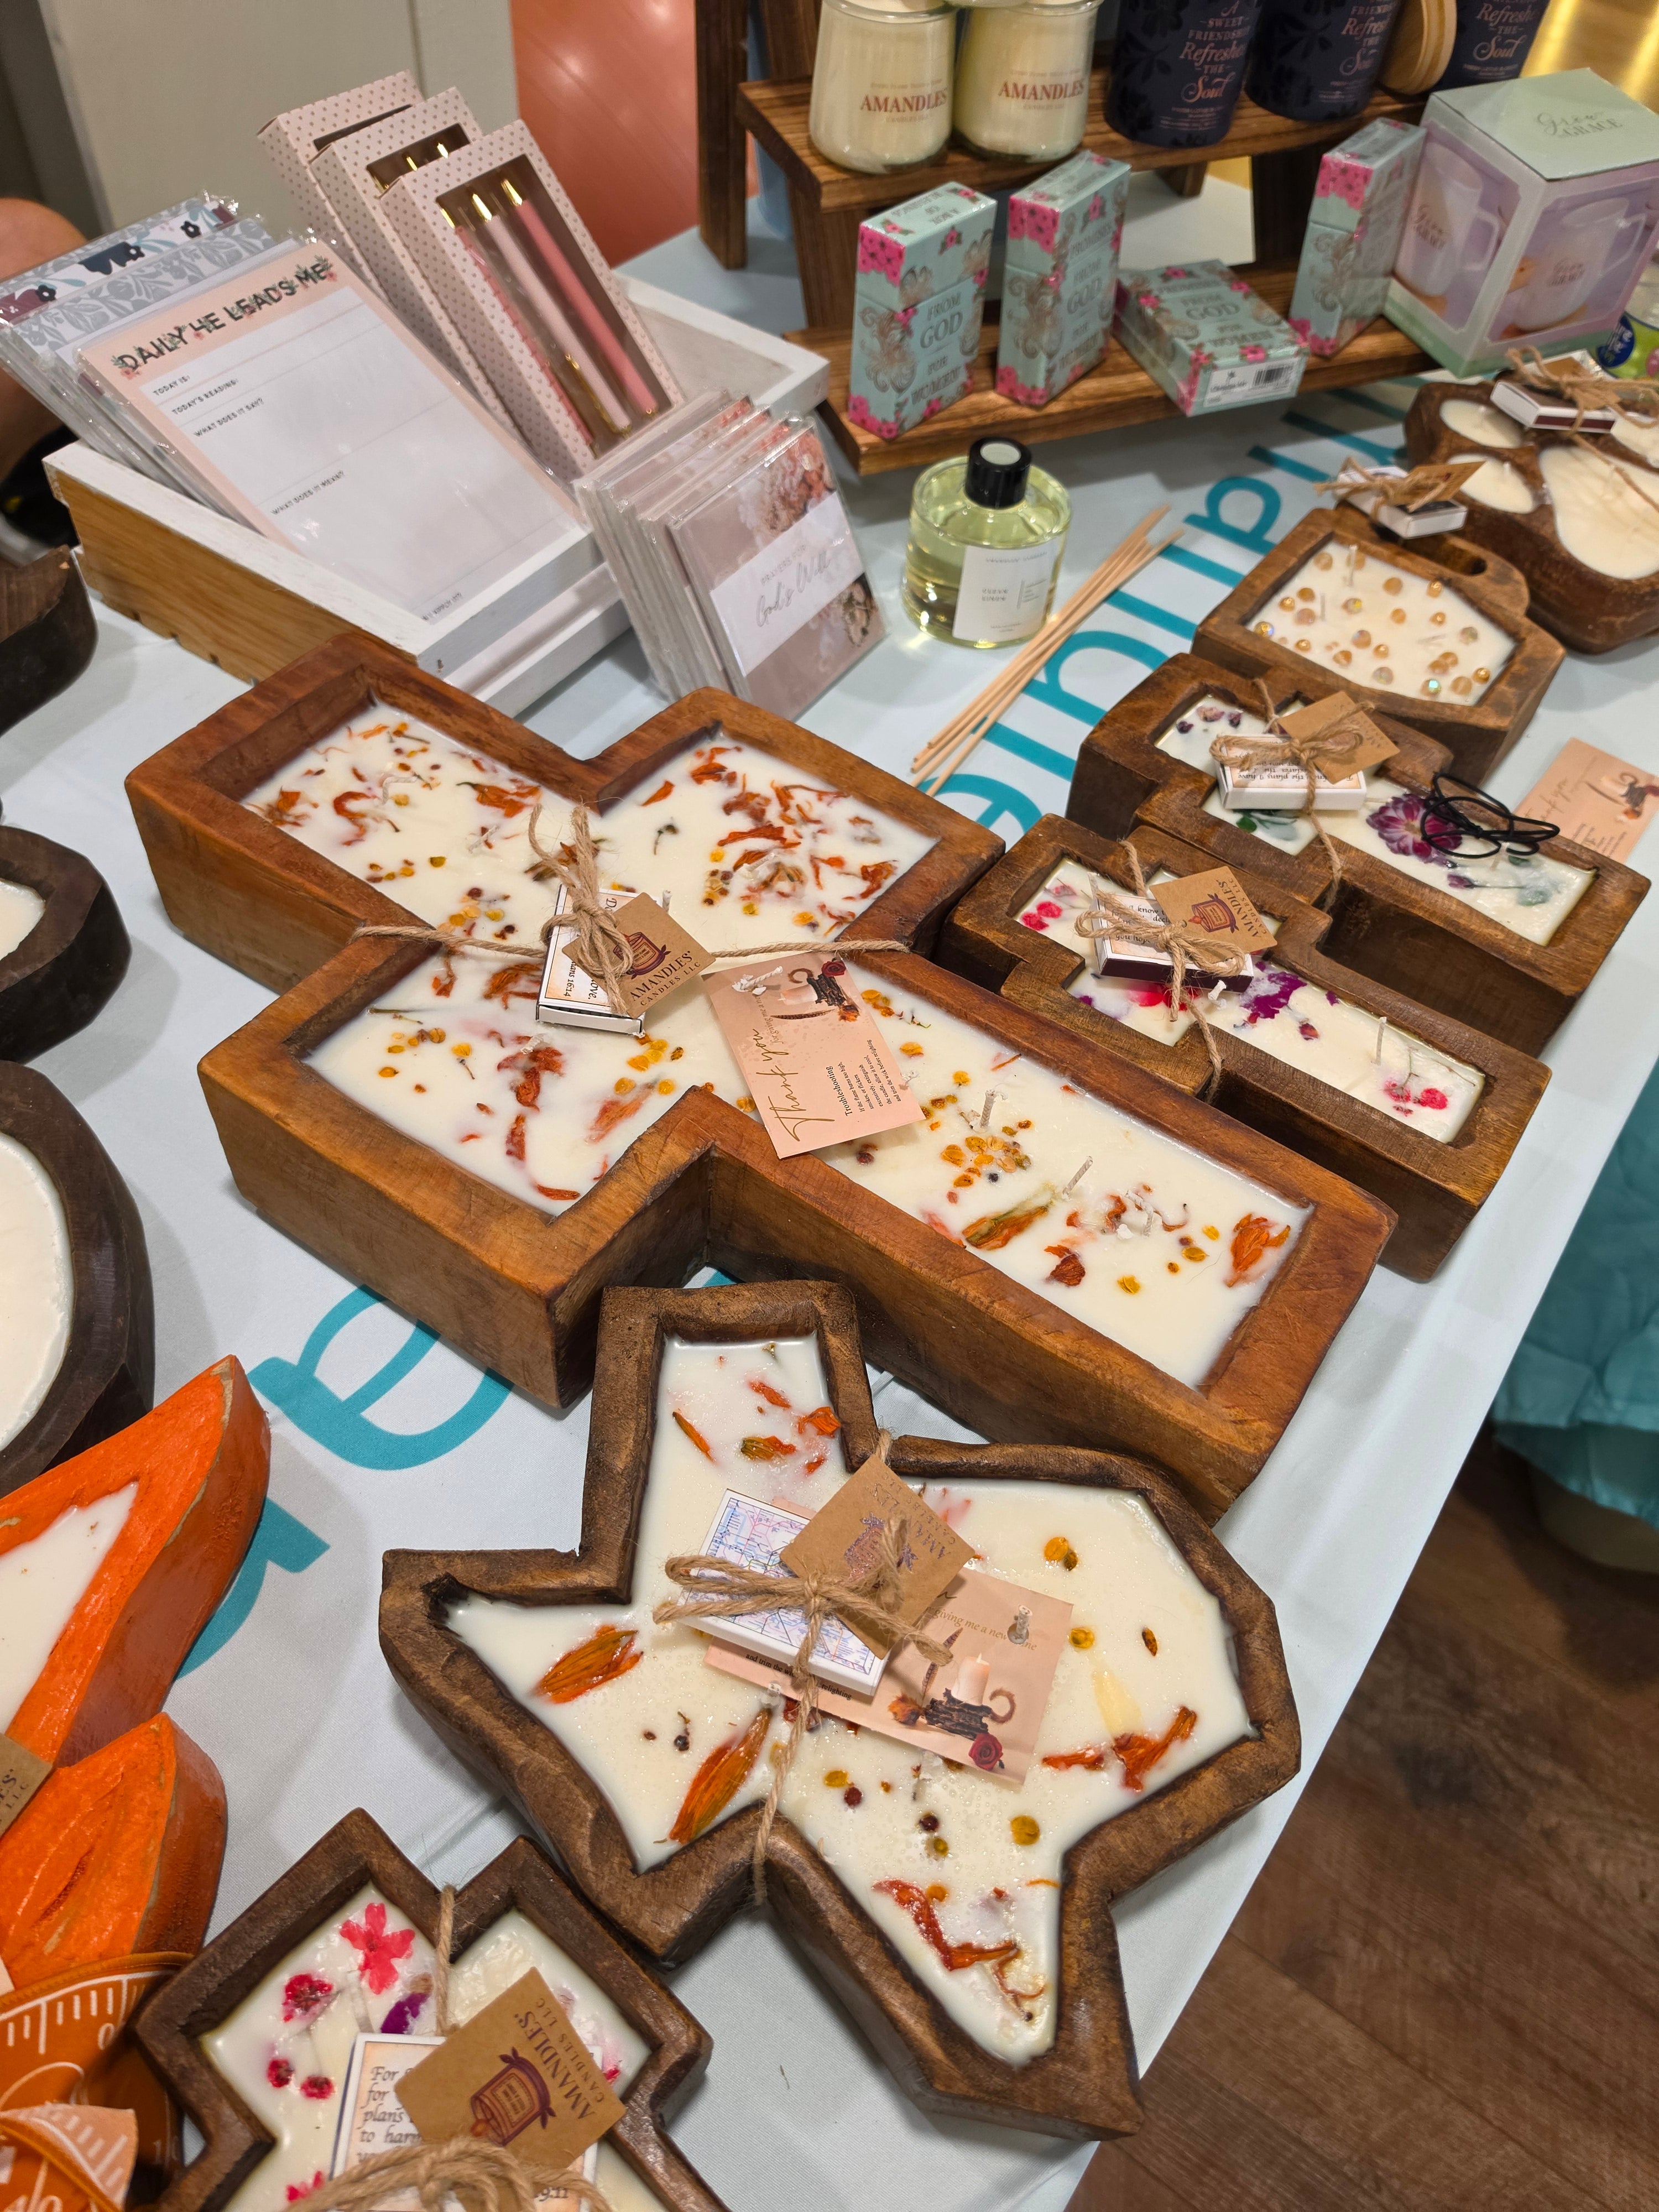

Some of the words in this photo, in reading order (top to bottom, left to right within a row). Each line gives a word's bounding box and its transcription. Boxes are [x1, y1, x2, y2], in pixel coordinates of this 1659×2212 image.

[1208, 16, 1244, 27] SWEET
[1473, 35, 1527, 61] Soul
[998, 79, 1085, 101] AMANDLES
[1182, 72, 1235, 102] Soul
[860, 88, 947, 113] AMANDLES
[116, 325, 189, 371] DAILY
[223, 280, 296, 321] LEADS
[295, 263, 328, 284] ME
[1186, 304, 1240, 320] GOD
[920, 311, 963, 348] GOD
[153, 380, 178, 396] TODAY
[172, 396, 204, 415] TODAY'S
[1228, 878, 1240, 893] LLC
[1138, 906, 1158, 914] know
[1240, 897, 1267, 934] CANDLES
[564, 979, 575, 997] 16:14
[640, 976, 681, 1006] CANDLES
[684, 962, 701, 975] LLC
[764, 1016, 779, 1036] giving
[753, 1029, 789, 1061] you
[770, 1032, 784, 1044] for
[867, 1039, 878, 1057] relighting
[863, 1055, 872, 1064] cool,
[875, 1057, 884, 1070] before
[854, 1074, 863, 1088] flickers
[858, 1064, 871, 1083] extinguish
[826, 1066, 852, 1115] Troubleshooting
[869, 1083, 883, 1106] excessively,
[879, 1083, 888, 1097] candle,
[756, 1065, 835, 1141] Thank
[864, 1093, 874, 1109] smokes,
[933, 1609, 963, 1627] giving
[964, 1620, 980, 1630] me
[745, 1653, 757, 1662] and
[759, 1658, 771, 1668] trim
[773, 1664, 783, 1672] the
[821, 1683, 852, 1700] relighting
[6, 1782, 29, 1810] LLC
[536, 1998, 557, 2027] LLC
[371, 2066, 399, 2081] For
[559, 2033, 604, 2103] CANDLES
[361, 2082, 390, 2109] for
[357, 2103, 404, 2130] plans
[361, 2131, 375, 2143] to
[534, 2187, 569, 2201] 9:11
